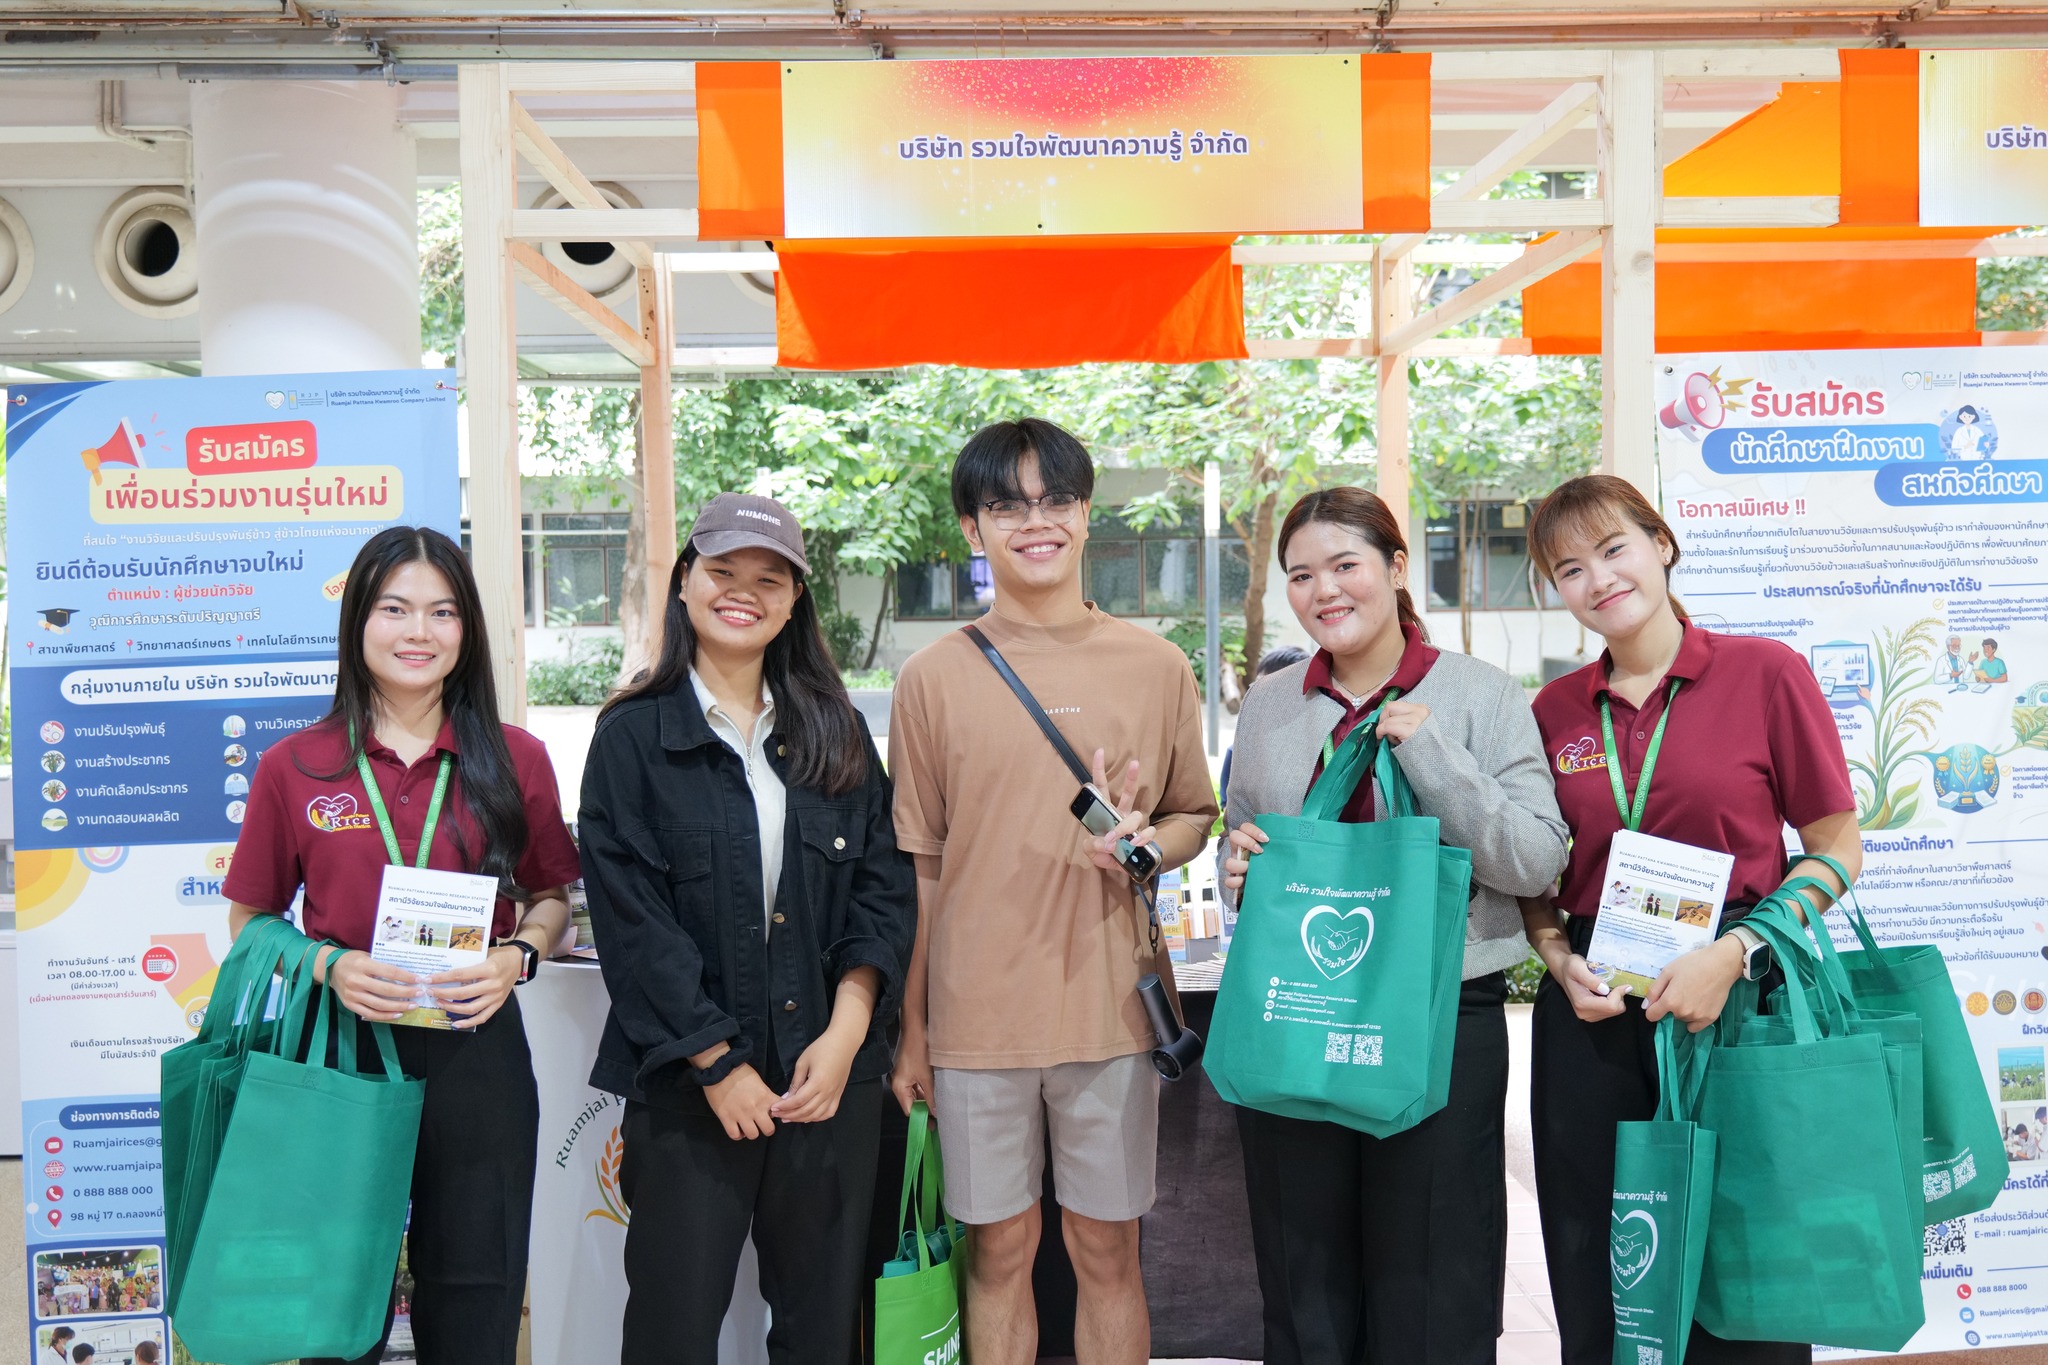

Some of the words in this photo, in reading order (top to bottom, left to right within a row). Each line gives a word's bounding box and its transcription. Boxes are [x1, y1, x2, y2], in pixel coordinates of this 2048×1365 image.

[1987, 126, 2047, 148] บริษัท
[900, 136, 962, 159] บริษัท
[971, 132, 1182, 161] รวมใจพัฒนาความรู้
[1190, 132, 1248, 154] จำกัด
[400, 397, 425, 405] Company
[1751, 381, 1885, 418] รับสมัคร
[198, 434, 305, 464] รับสมัคร
[1730, 428, 1924, 464] นักศึกษาฝึกงาน
[1902, 462, 2042, 498] สหกิจศึกษา
[105, 473, 388, 516] เพื่อนร่วมงานรุ่นใหม่
[1677, 499, 1789, 519] โอกาสพิเศษ
[83, 533, 117, 547] ที่สนใจ
[1680, 545, 1788, 558] วามตั้งใจและรักในการเรียนรู้
[36, 550, 304, 581] ยินดีต้อนรับนักศึกษาจบใหม่
[107, 586, 161, 602] ตำแหน่ง
[174, 584, 253, 603] ผู้ช่วยนักวิจัย
[326, 579, 347, 598] โอก
[1763, 576, 1982, 599] ประสบการณ์จริงที่นักศึกษาจะได้รับ
[89, 608, 261, 630] วุฒิการศึกษาระดับปริญญาตรี
[38, 642, 116, 656] สาขาพืชศาสตร์
[137, 637, 232, 653] วิทยาศาสตร์เกษตร
[247, 633, 341, 647] เทคโนโลยีการเกษ
[71, 676, 179, 698] กลุ่มงานภายใน
[186, 675, 228, 690] บริษัท
[234, 672, 338, 689] รวมใจพัฒนาค
[74, 722, 166, 739] งานปรับปรุงพันธุ์
[75, 753, 171, 768] งานสร้างประชากร
[76, 782, 189, 798] งานคัดเลือกประชากร
[77, 811, 180, 826] งานทดสอบผลผลิต
[1619, 861, 1715, 891] สถานีวิจัยรวมใจพัฒนาความรู้
[1285, 882, 1309, 893] บริษัท
[388, 896, 486, 915] สถานีวิจัยรวมใจพัฒนาความรู้
[1993, 926, 2025, 940] อยู่เสมอ
[47, 957, 109, 967] ทำงานวันจันทร์
[118, 955, 136, 965] เสาร์
[47, 972, 67, 980] เวลา
[69, 970, 126, 979] 08.00-17.00
[100, 1049, 157, 1060] มีโบนัสประจำปี
[71, 1108, 160, 1122] ช่องทางการติดต่อ
[556, 1092, 609, 1171] Ruamjai
[73, 1137, 163, 1149] Ruamjairices@g
[73, 1161, 162, 1173] www.ruamjaipa
[73, 1189, 81, 1197] 0
[84, 1188, 105, 1197] 888
[108, 1186, 129, 1196] 888
[131, 1185, 153, 1195] 000
[70, 1212, 84, 1221] 98
[87, 1210, 100, 1222] หมู่
[103, 1211, 113, 1220] 17
[116, 1206, 165, 1219] ต.คลองหนึ่
[1974, 1231, 2001, 1239] E-mail
[1922, 1262, 1973, 1280] เพิ่มเติม
[1977, 1286, 1992, 1294] 088
[1993, 1285, 2007, 1293] 888
[2008, 1284, 2028, 1292] 8000
[924, 1326, 960, 1365] SHIN
